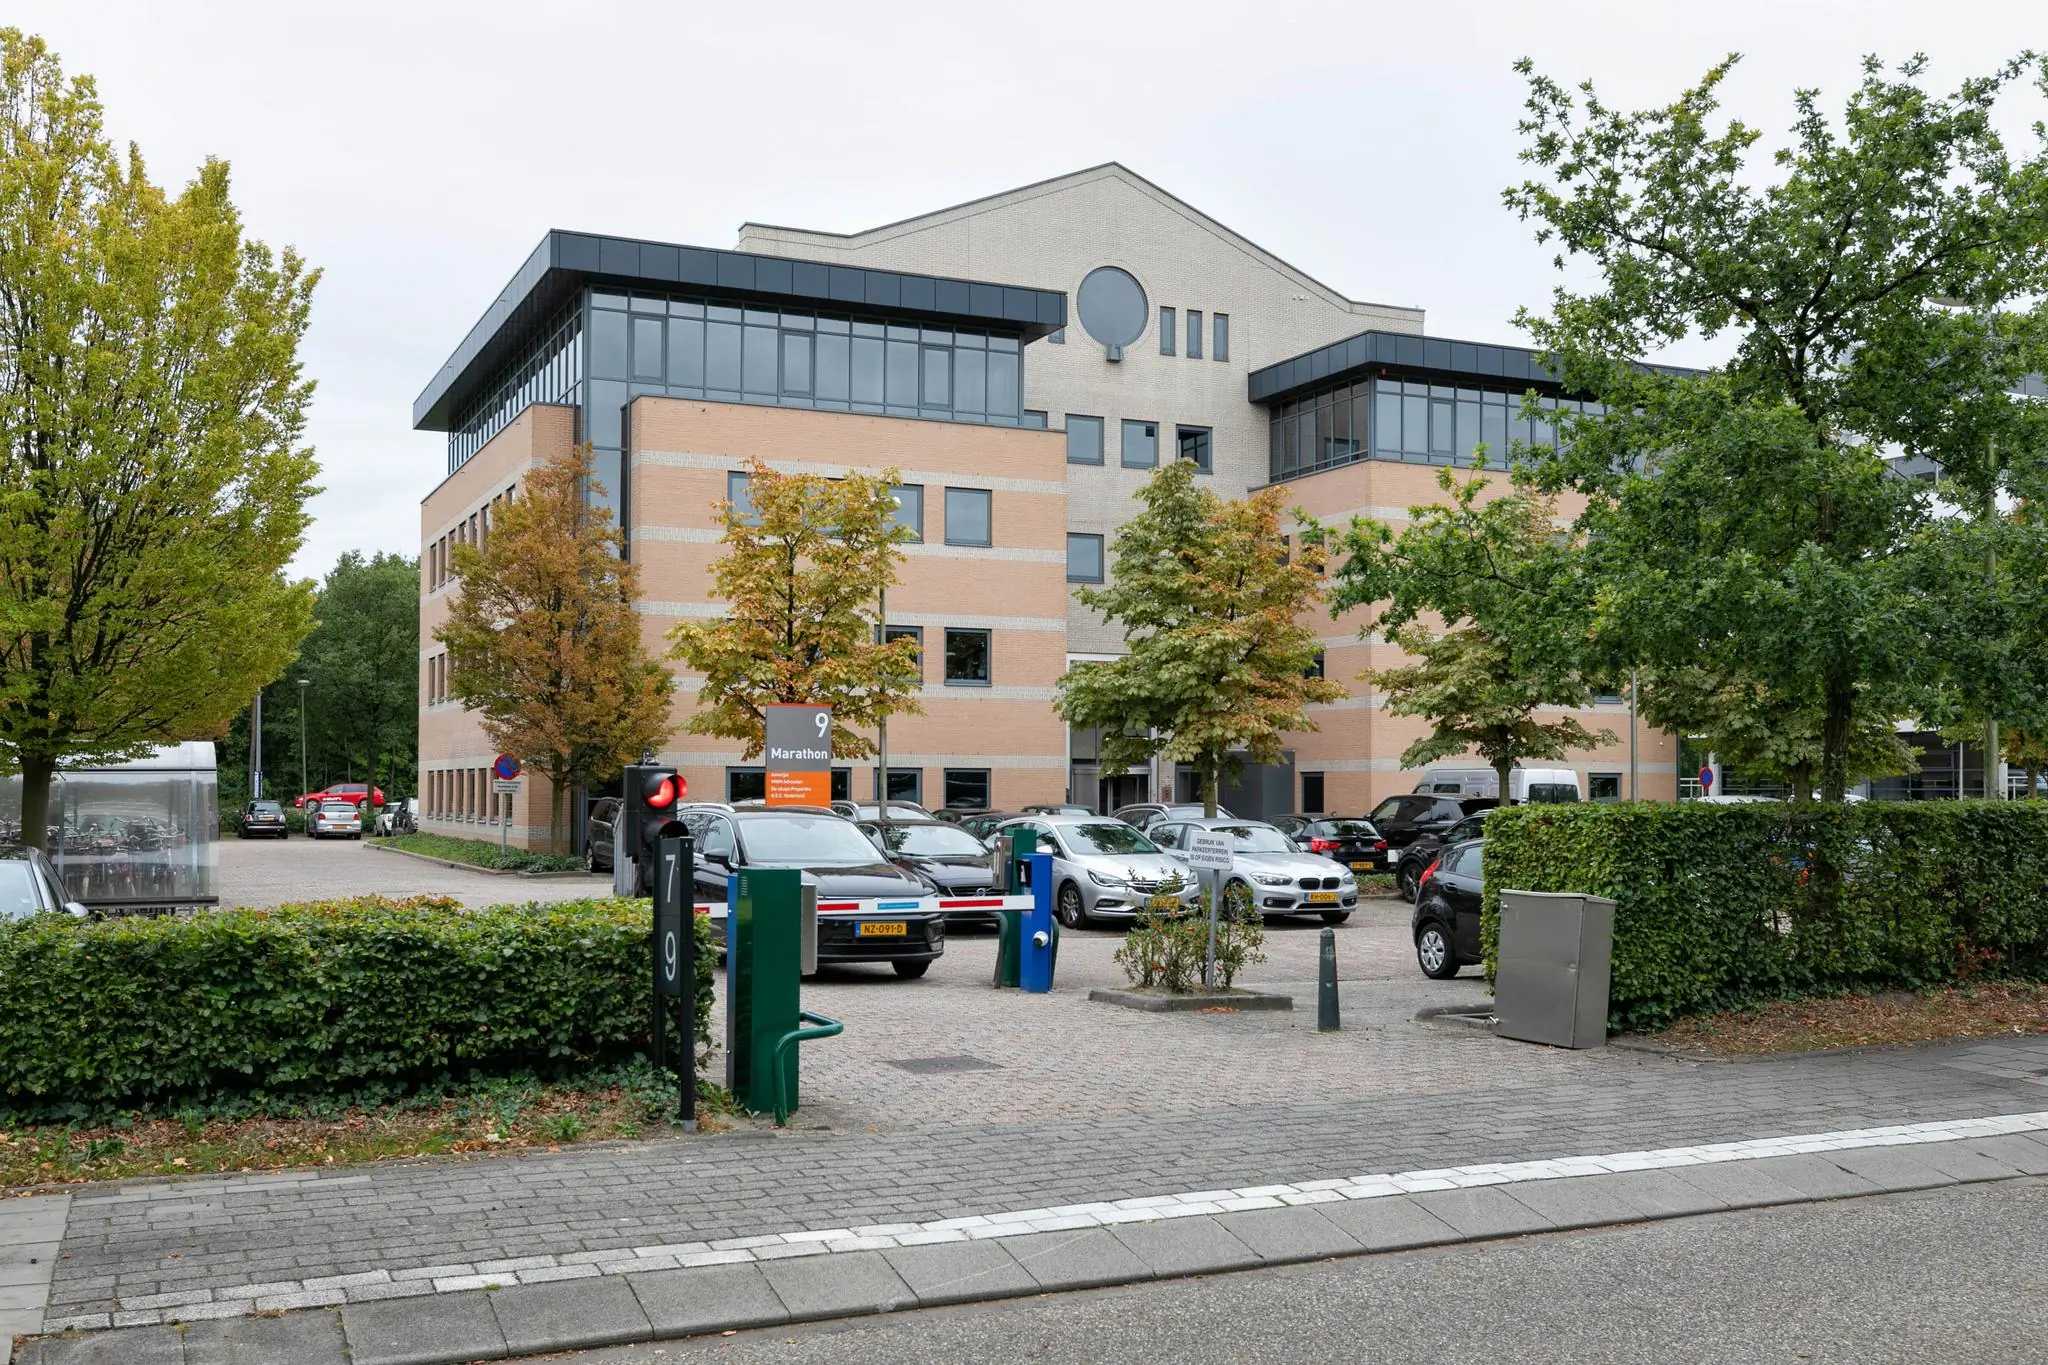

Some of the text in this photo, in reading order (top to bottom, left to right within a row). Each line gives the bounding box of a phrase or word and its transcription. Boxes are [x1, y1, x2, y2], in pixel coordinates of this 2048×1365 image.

[815, 712, 829, 738] 9
[771, 747, 828, 759] Marathon
[1197, 838, 1215, 846] GEBRUIK
[1191, 846, 1229, 855] PARKEERTERREIN
[1215, 856, 1230, 864] RISICO
[665, 854, 676, 903] 7
[864, 924, 903, 934] NZ-091-D
[665, 931, 676, 981] 9
